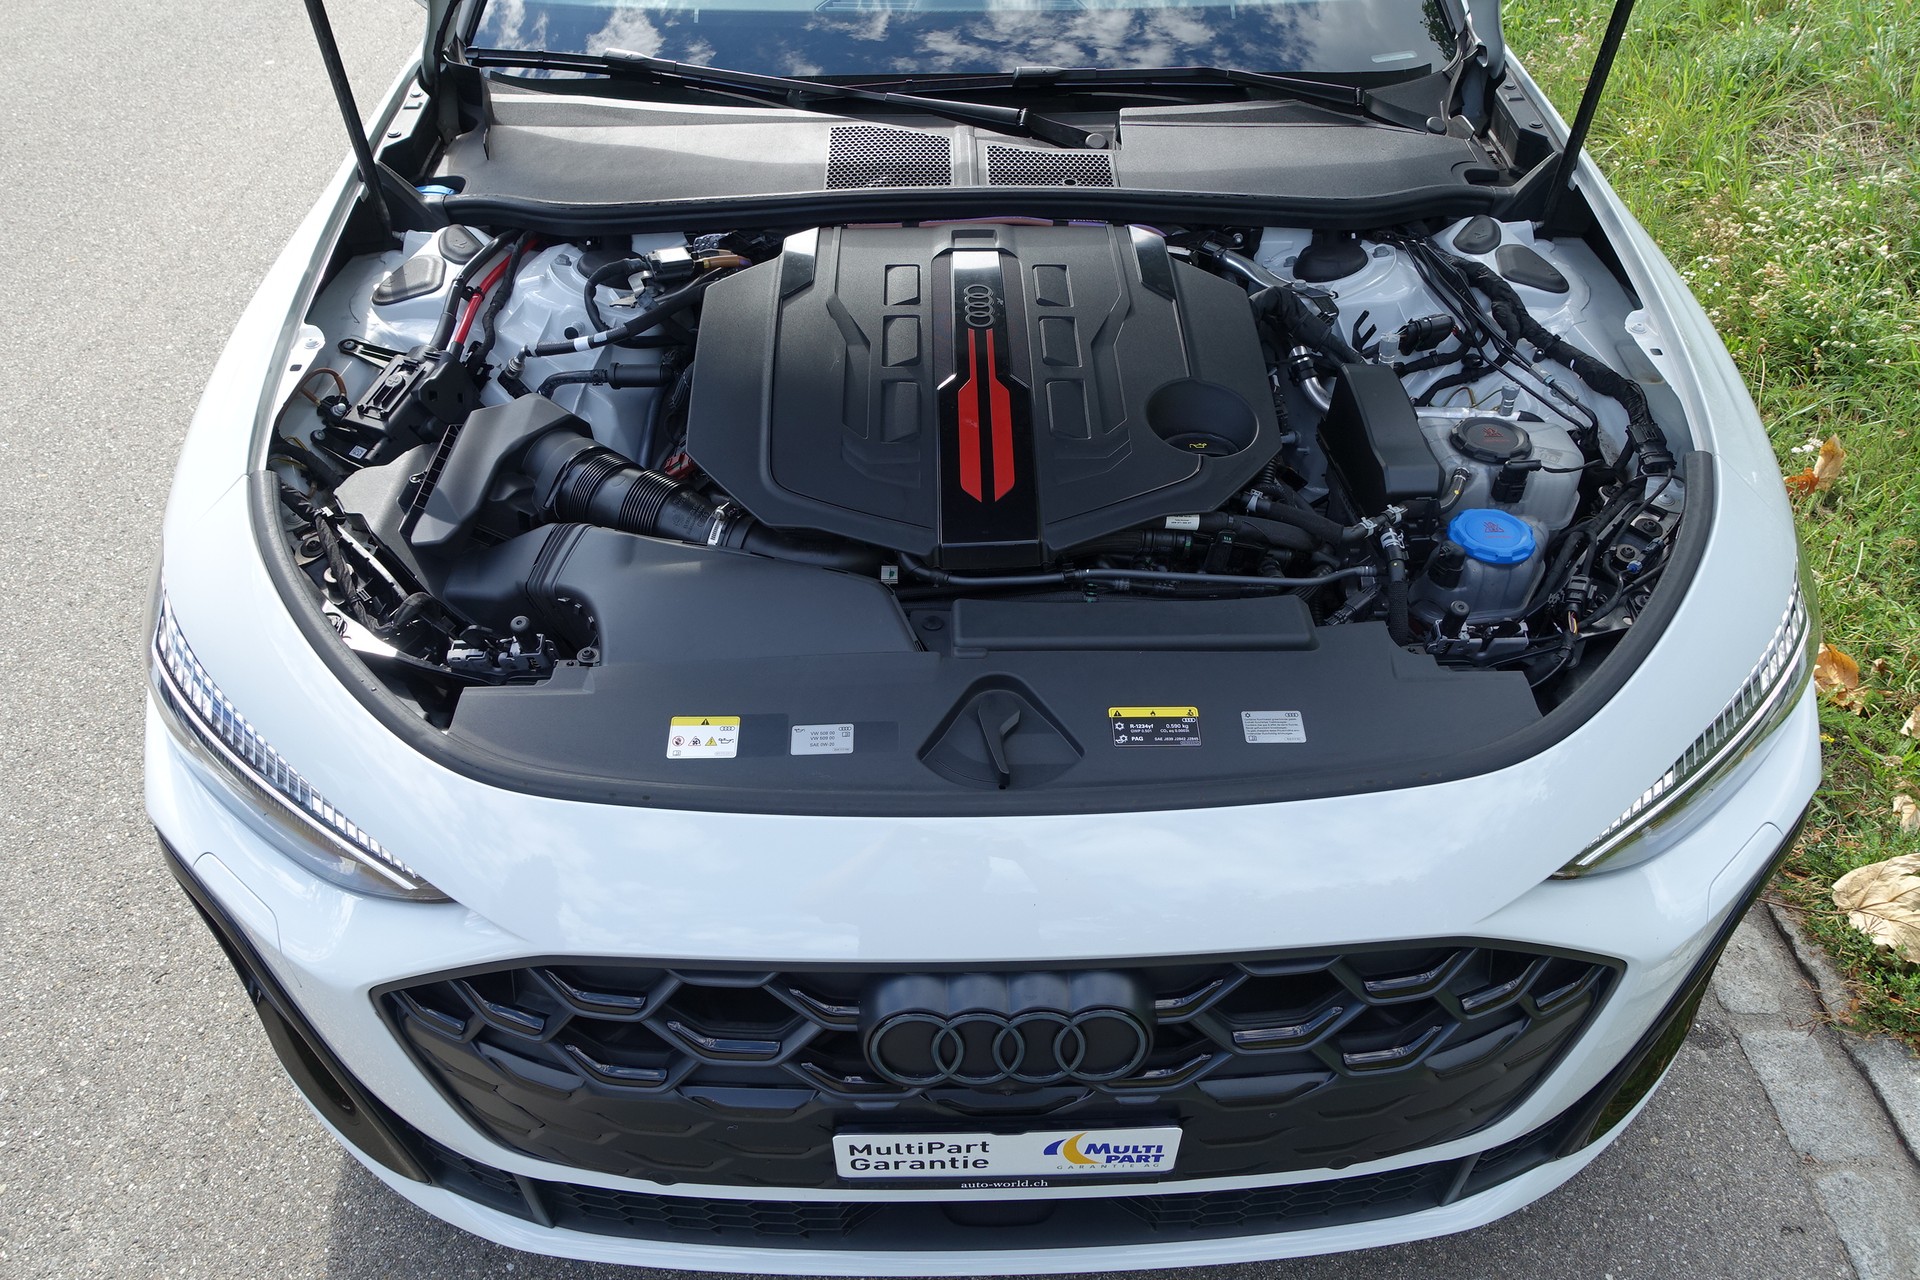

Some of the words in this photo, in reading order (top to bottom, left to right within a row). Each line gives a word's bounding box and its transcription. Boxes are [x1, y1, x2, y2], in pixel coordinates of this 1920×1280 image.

[848, 1141, 989, 1156] MultiPart
[1084, 1143, 1163, 1154] MULTI
[850, 1156, 989, 1171] Garantie
[1105, 1154, 1164, 1163] PART
[961, 1180, 1048, 1189] auto-world.ch
